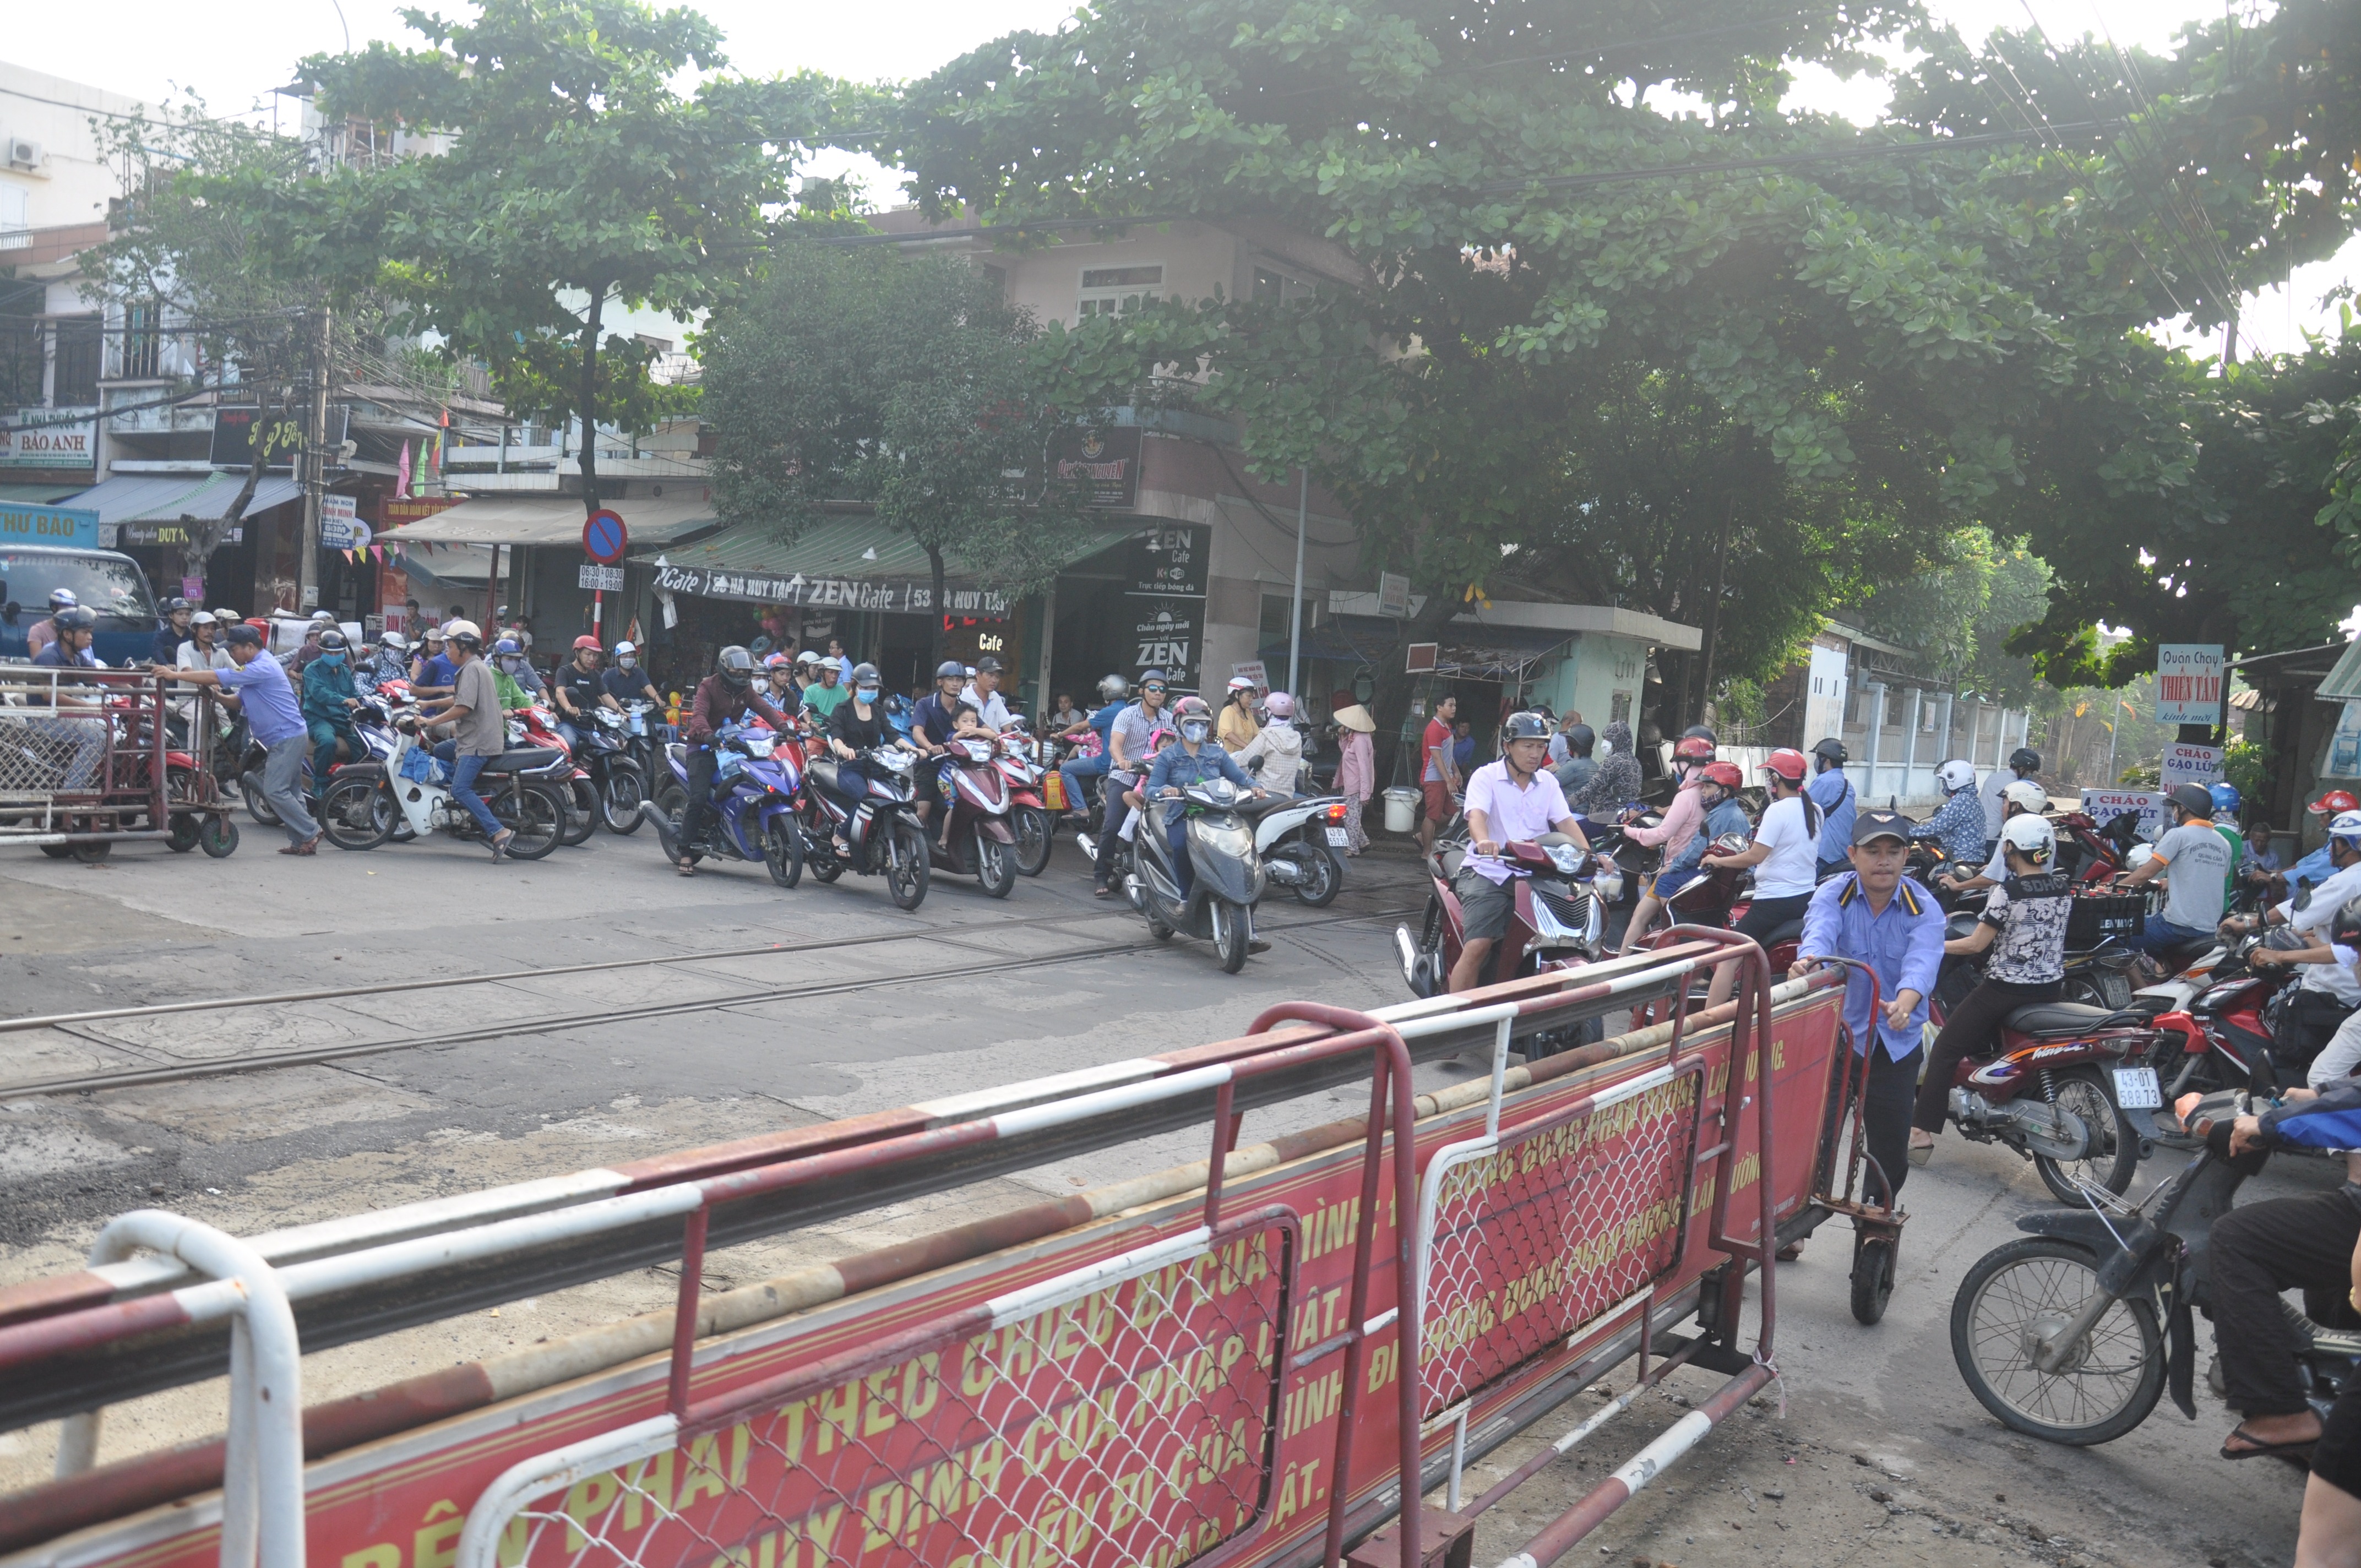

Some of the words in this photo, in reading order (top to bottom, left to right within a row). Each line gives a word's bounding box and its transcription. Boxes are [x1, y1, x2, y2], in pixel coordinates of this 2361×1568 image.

[21, 430, 49, 450] BẢO
[52, 435, 86, 450] ANH
[0, 511, 32, 533] HƯ
[158, 527, 178, 543] DUY
[1172, 550, 1190, 563] Cafe
[581, 566, 600, 578] 06:30
[605, 569, 623, 579] 08:30
[581, 577, 599, 588] 16:00
[605, 579, 622, 590] 19:00
[662, 567, 699, 592] Cafe
[746, 579, 770, 597] HUY
[771, 579, 793, 602] TẬP
[1168, 582, 1184, 592] bóng
[189, 589, 198, 597] 175
[807, 580, 859, 607] ZEN
[860, 582, 894, 609] Cafe
[913, 589, 931, 607] 53
[954, 591, 981, 610] HUY
[1136, 623, 1155, 632] Chào
[1156, 623, 1174, 632] ngày
[1175, 620, 1190, 629] mới
[979, 633, 1003, 651] Cafe
[1136, 641, 1189, 666] ZEN
[2163, 650, 2190, 665] Quán
[2194, 651, 2218, 668] Chay
[1166, 666, 1186, 682] Cafe
[2160, 665, 2194, 713] THIỆN
[2195, 665, 2220, 704] TÂM
[2162, 712, 2188, 721] kính
[2175, 748, 2211, 759] CHÁO
[2167, 758, 2193, 770] GẠO
[2099, 794, 2148, 805] CHÁO
[2089, 807, 2122, 818] GẠO
[1022, 1382, 1117, 1477] CỦA
[1134, 1329, 1244, 1428] PHÁP
[1168, 1414, 1246, 1500] CỦA
